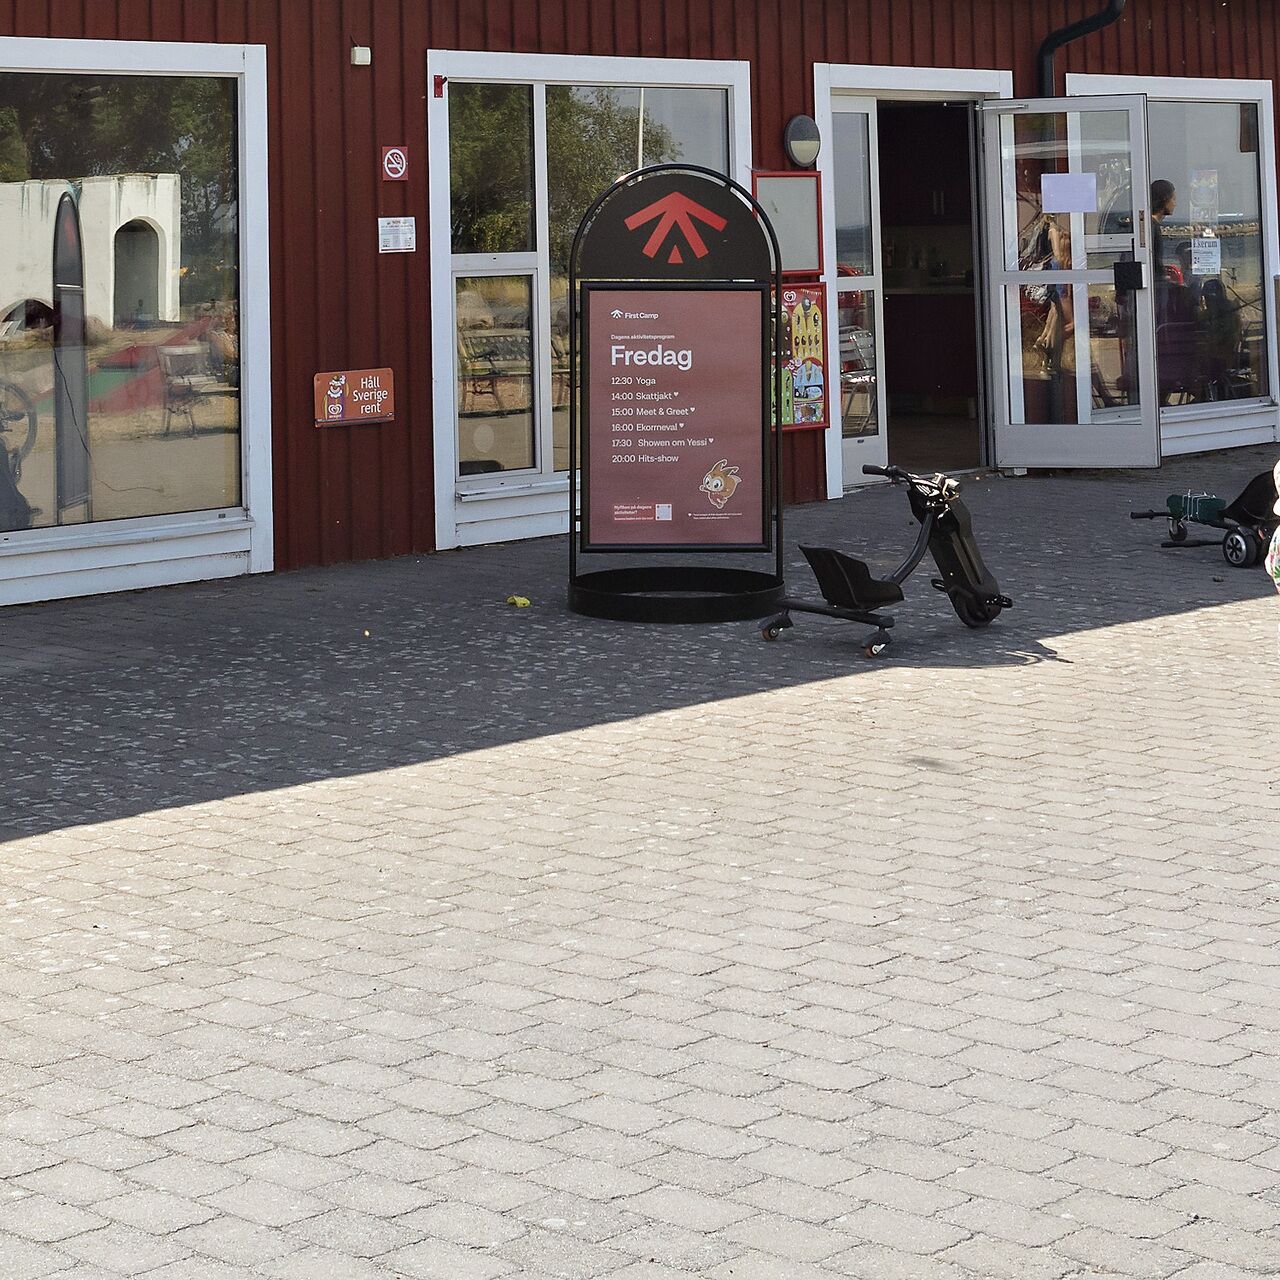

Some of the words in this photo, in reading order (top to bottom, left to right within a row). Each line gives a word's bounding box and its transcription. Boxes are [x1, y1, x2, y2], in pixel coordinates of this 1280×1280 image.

[639, 312, 659, 320] Camp
[611, 344, 692, 371] Fredag
[361, 375, 380, 389] Håll
[611, 377, 633, 385] 12:30
[636, 377, 656, 386] Yoga
[352, 389, 388, 402] Sverige
[611, 392, 634, 400] 14:00
[635, 391, 673, 401] Skattjakt
[360, 403, 381, 414] rent
[611, 408, 634, 416] 15:00
[636, 407, 657, 416] Meet
[658, 407, 665, 415] &
[666, 407, 689, 415] Greet
[611, 423, 634, 432] 16:00
[612, 439, 632, 447] 17:30
[637, 438, 671, 447] Showen
[687, 438, 708, 446] Yessi
[612, 454, 636, 463] 20:00
[638, 454, 679, 463] Hits-show
